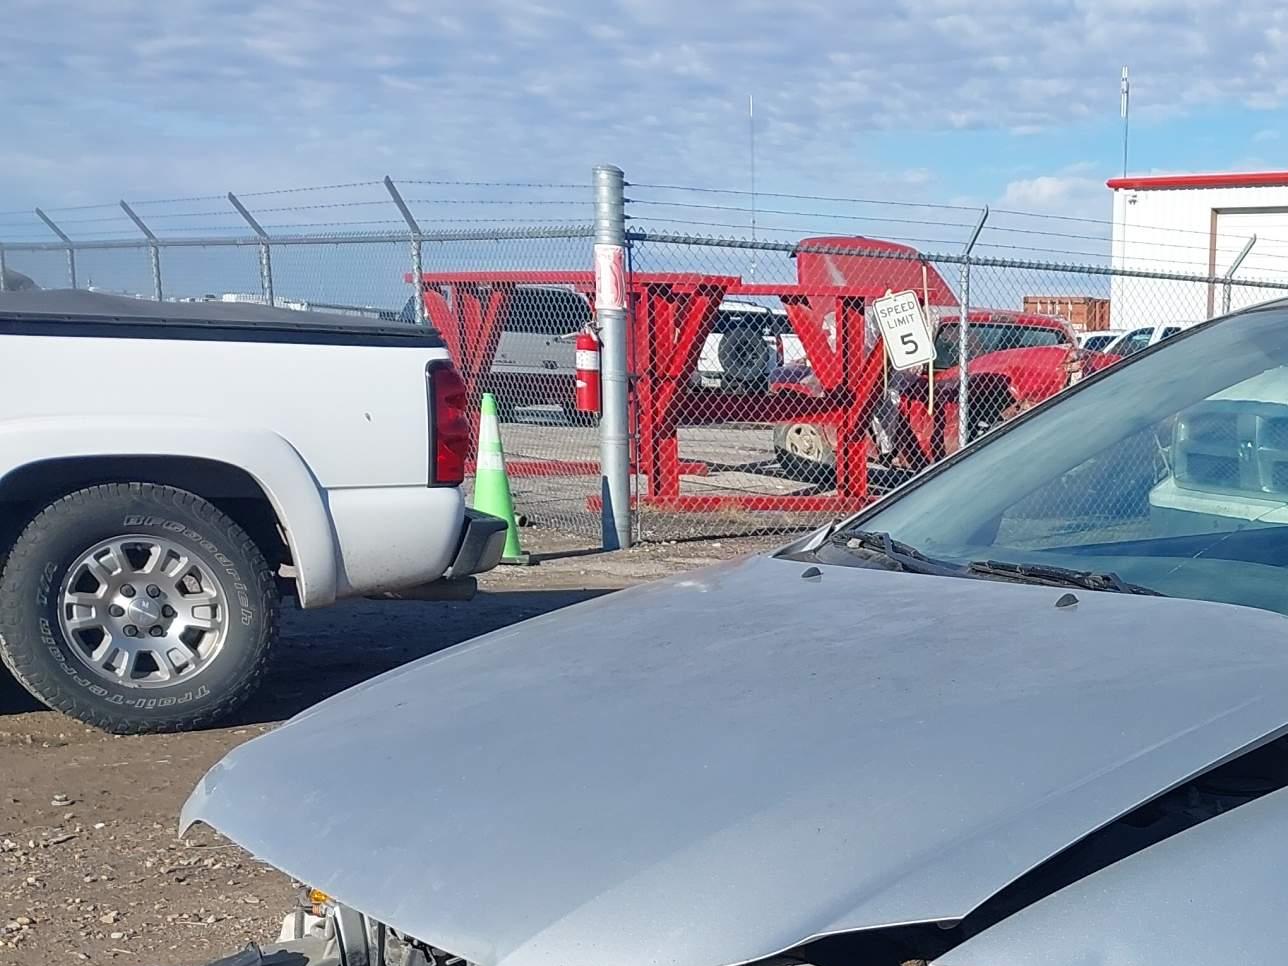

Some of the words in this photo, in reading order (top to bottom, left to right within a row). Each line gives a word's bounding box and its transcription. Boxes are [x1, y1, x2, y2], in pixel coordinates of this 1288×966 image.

[880, 301, 914, 318] SPEED
[887, 313, 914, 329] LIMIT
[900, 332, 919, 355] 5
[123, 514, 253, 627] BFGoodrich
